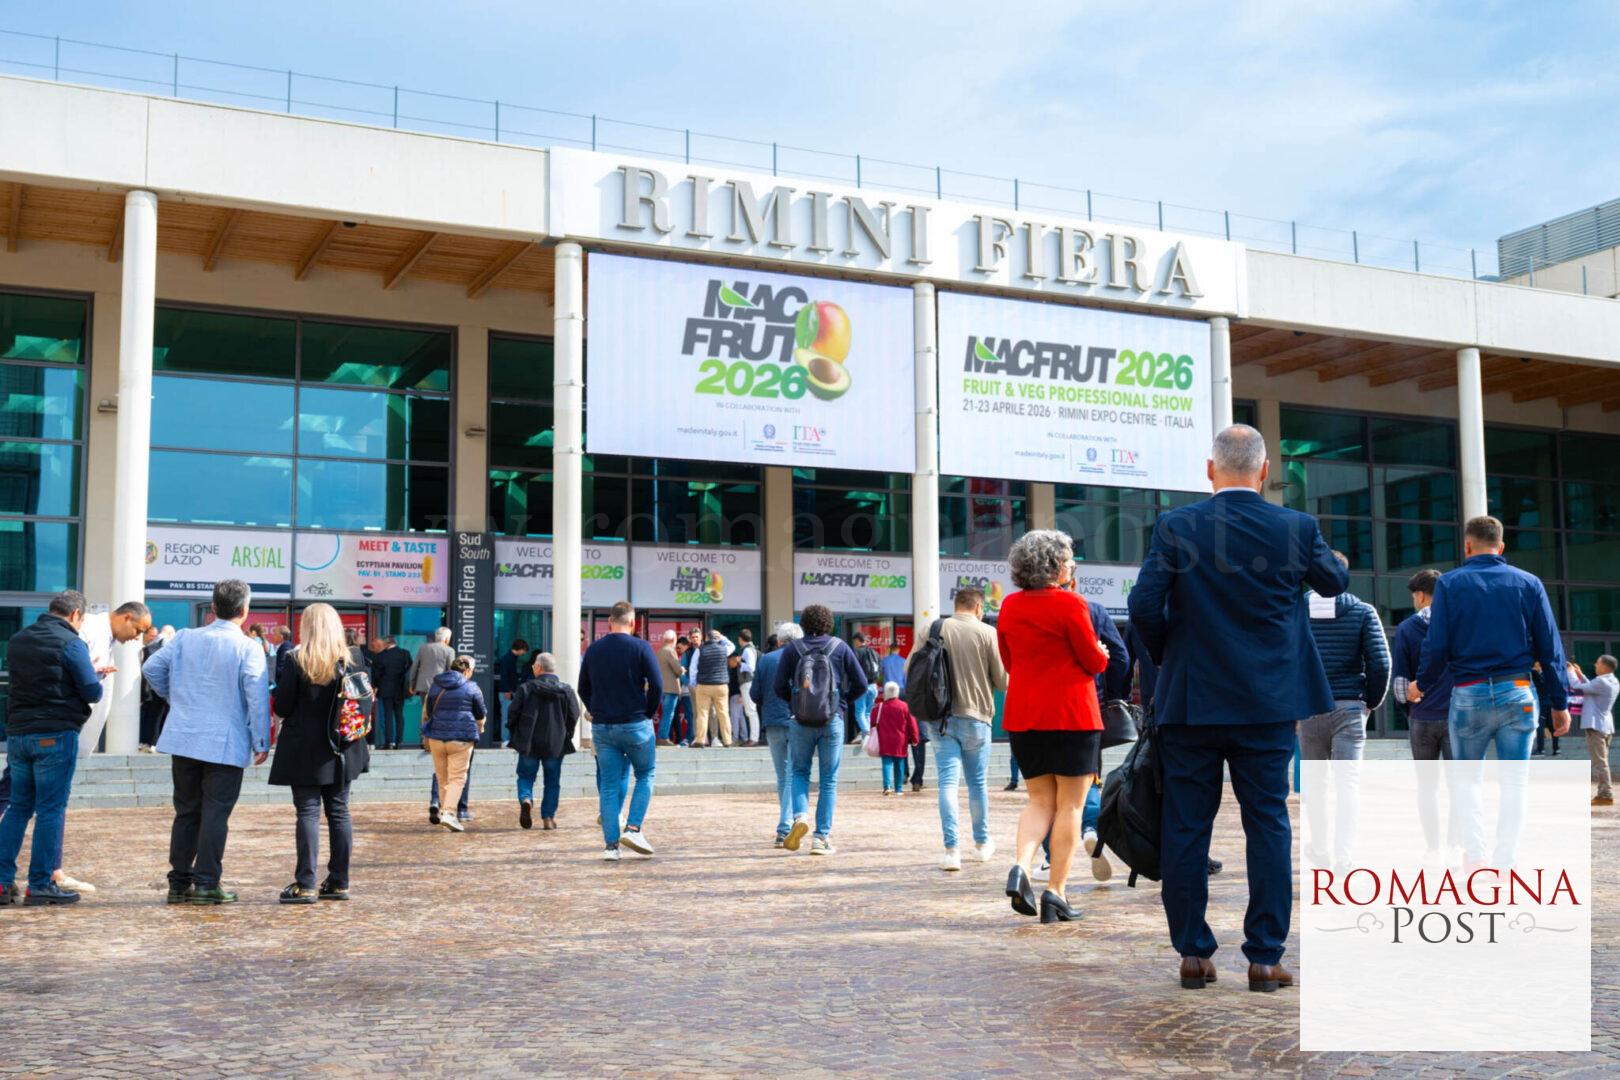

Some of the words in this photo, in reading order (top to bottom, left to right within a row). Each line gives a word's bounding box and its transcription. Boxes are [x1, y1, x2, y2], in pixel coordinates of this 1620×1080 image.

[617, 164, 932, 264] RIMINI
[973, 214, 1205, 298] FIERA
[703, 279, 808, 325] MAC
[681, 317, 798, 363] FRUT
[964, 335, 1116, 384] MACFRUT
[1115, 349, 1194, 390] 2026
[695, 359, 809, 400] 2026
[963, 378, 1000, 396] FRUIT
[1005, 382, 1015, 398] &
[1019, 384, 1045, 400] VEG
[1049, 386, 1149, 409] PROFESSIONAL
[1152, 395, 1194, 412] SHOW
[725, 402, 783, 413] COLLABORATION
[962, 399, 990, 413] 21-23
[992, 401, 1025, 416] APRILE
[1028, 403, 1051, 418] 2026
[1058, 407, 1089, 421] RIMINI
[1091, 409, 1117, 424] EXPO
[1119, 411, 1157, 427] CENTRE
[1164, 415, 1194, 429] ITALIA
[459, 533, 481, 545] Sud
[164, 543, 220, 555] REGIONE
[358, 540, 390, 552] MEET
[391, 541, 401, 553] &
[403, 541, 437, 554] TASTE
[459, 547, 490, 560] South
[516, 546, 553, 559] WELC
[584, 549, 601, 560] TO
[164, 555, 202, 566] LAZIO
[231, 545, 285, 569] ARSIAL
[657, 551, 717, 564] WELCOME
[720, 553, 737, 564] TO
[817, 557, 873, 570] WELCOME
[876, 559, 891, 570] TO
[356, 560, 391, 569] EGYPTIAN
[391, 561, 423, 570] PAVILION
[495, 563, 554, 579] MACFR
[580, 564, 625, 580] 2026
[939, 562, 990, 574] WELCOME
[991, 563, 1006, 574] TO
[676, 566, 710, 580] MAC
[458, 565, 476, 601] Fiera
[670, 578, 706, 592] FRUT
[800, 572, 869, 588] MACFRUT
[869, 574, 907, 589] 2026
[1079, 576, 1115, 587] REGIONE
[674, 591, 710, 604] 2026
[1079, 586, 1104, 596] LAZIO
[457, 605, 475, 653] Rimini
